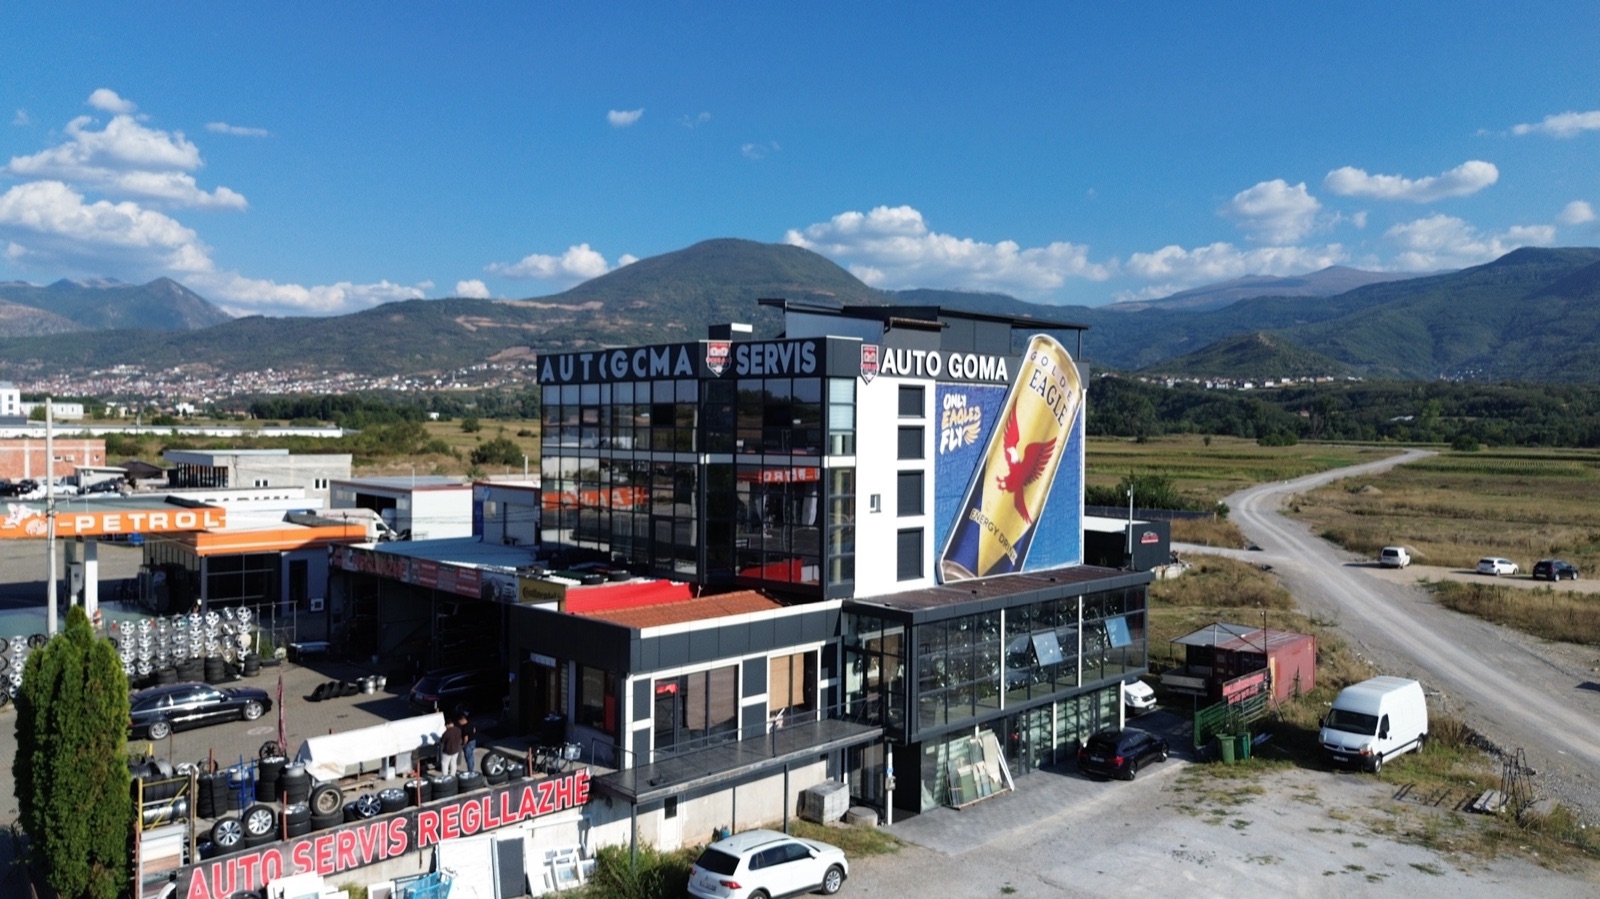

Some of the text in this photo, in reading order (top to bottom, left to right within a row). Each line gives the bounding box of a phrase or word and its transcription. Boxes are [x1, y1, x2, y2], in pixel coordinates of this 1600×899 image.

[736, 341, 816, 376] SERVIS
[881, 347, 942, 378] AUTO
[948, 352, 1009, 381] GOMA
[943, 393, 967, 410] ONLY
[1029, 369, 1067, 427] EAGLE
[941, 406, 981, 429] EAGLES
[939, 426, 963, 455] FLY
[75, 510, 219, 533] PETROL
[969, 508, 999, 536] ENERGY
[187, 766, 592, 899] AUTO SERVIS REGLLAZHË
